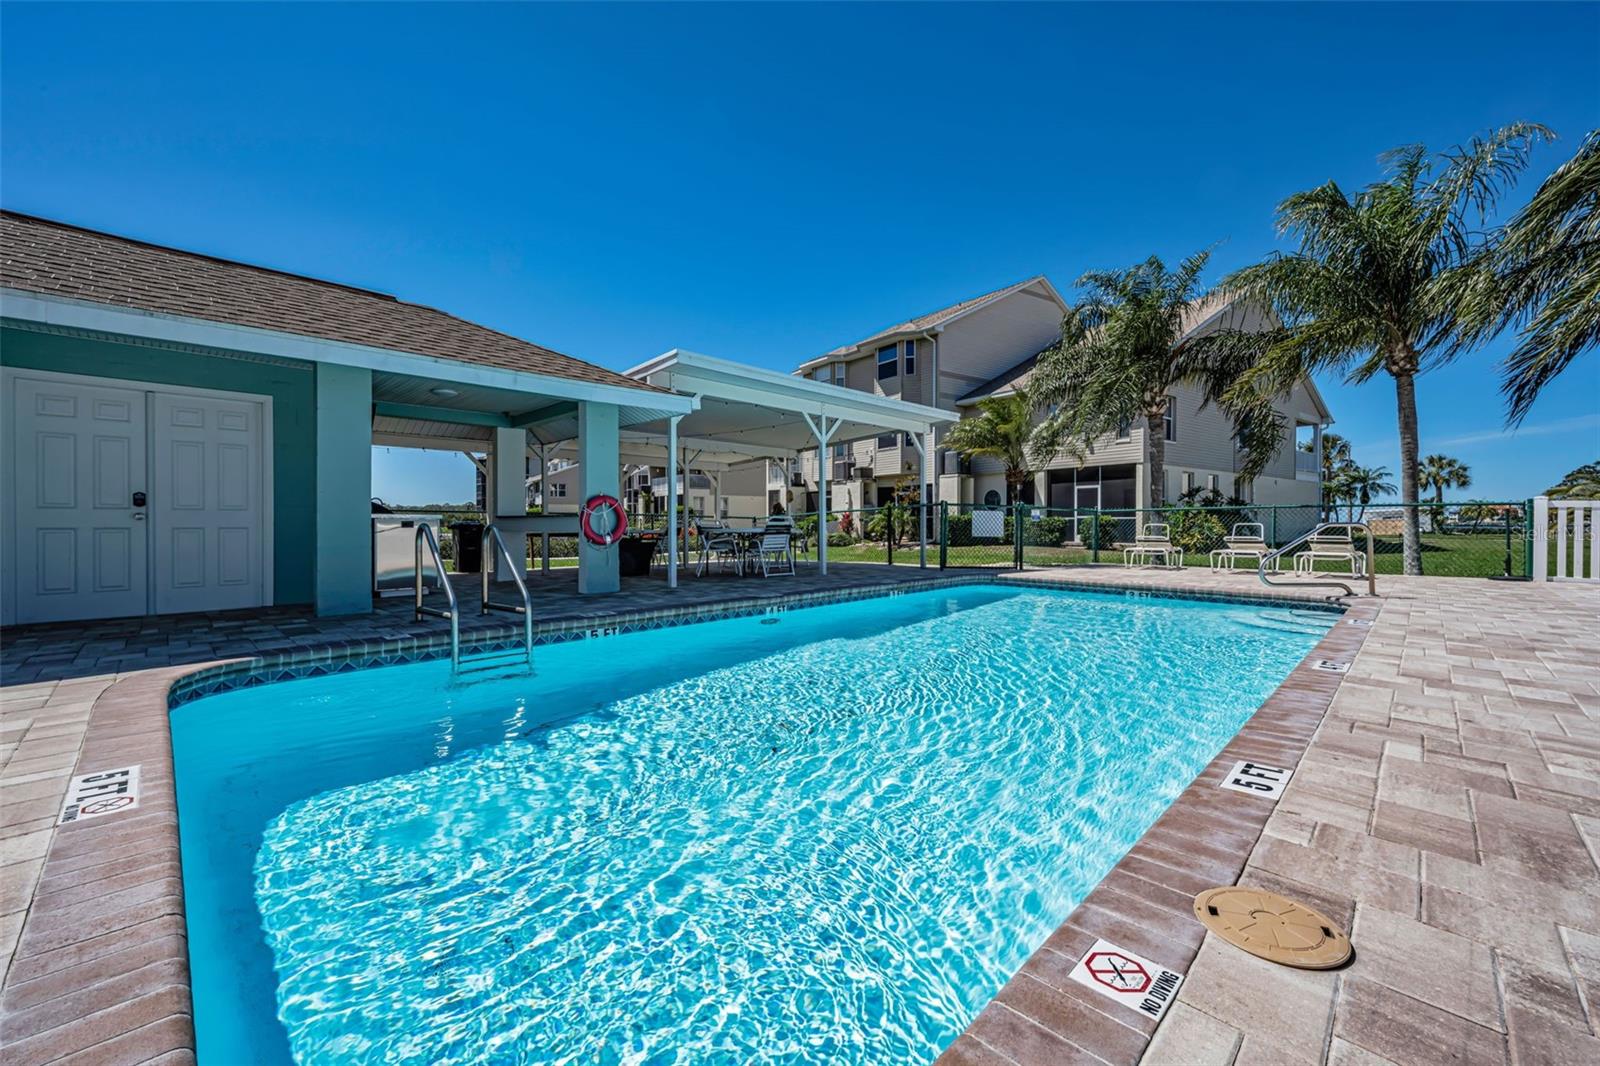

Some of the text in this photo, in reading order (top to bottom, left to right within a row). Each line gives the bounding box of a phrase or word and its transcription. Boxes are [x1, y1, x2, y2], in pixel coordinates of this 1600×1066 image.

[590, 626, 617, 638] 5 FT
[76, 770, 129, 802] 5 FT
[1231, 763, 1284, 792] 5 FT
[1140, 970, 1180, 1016] NO DIVING
